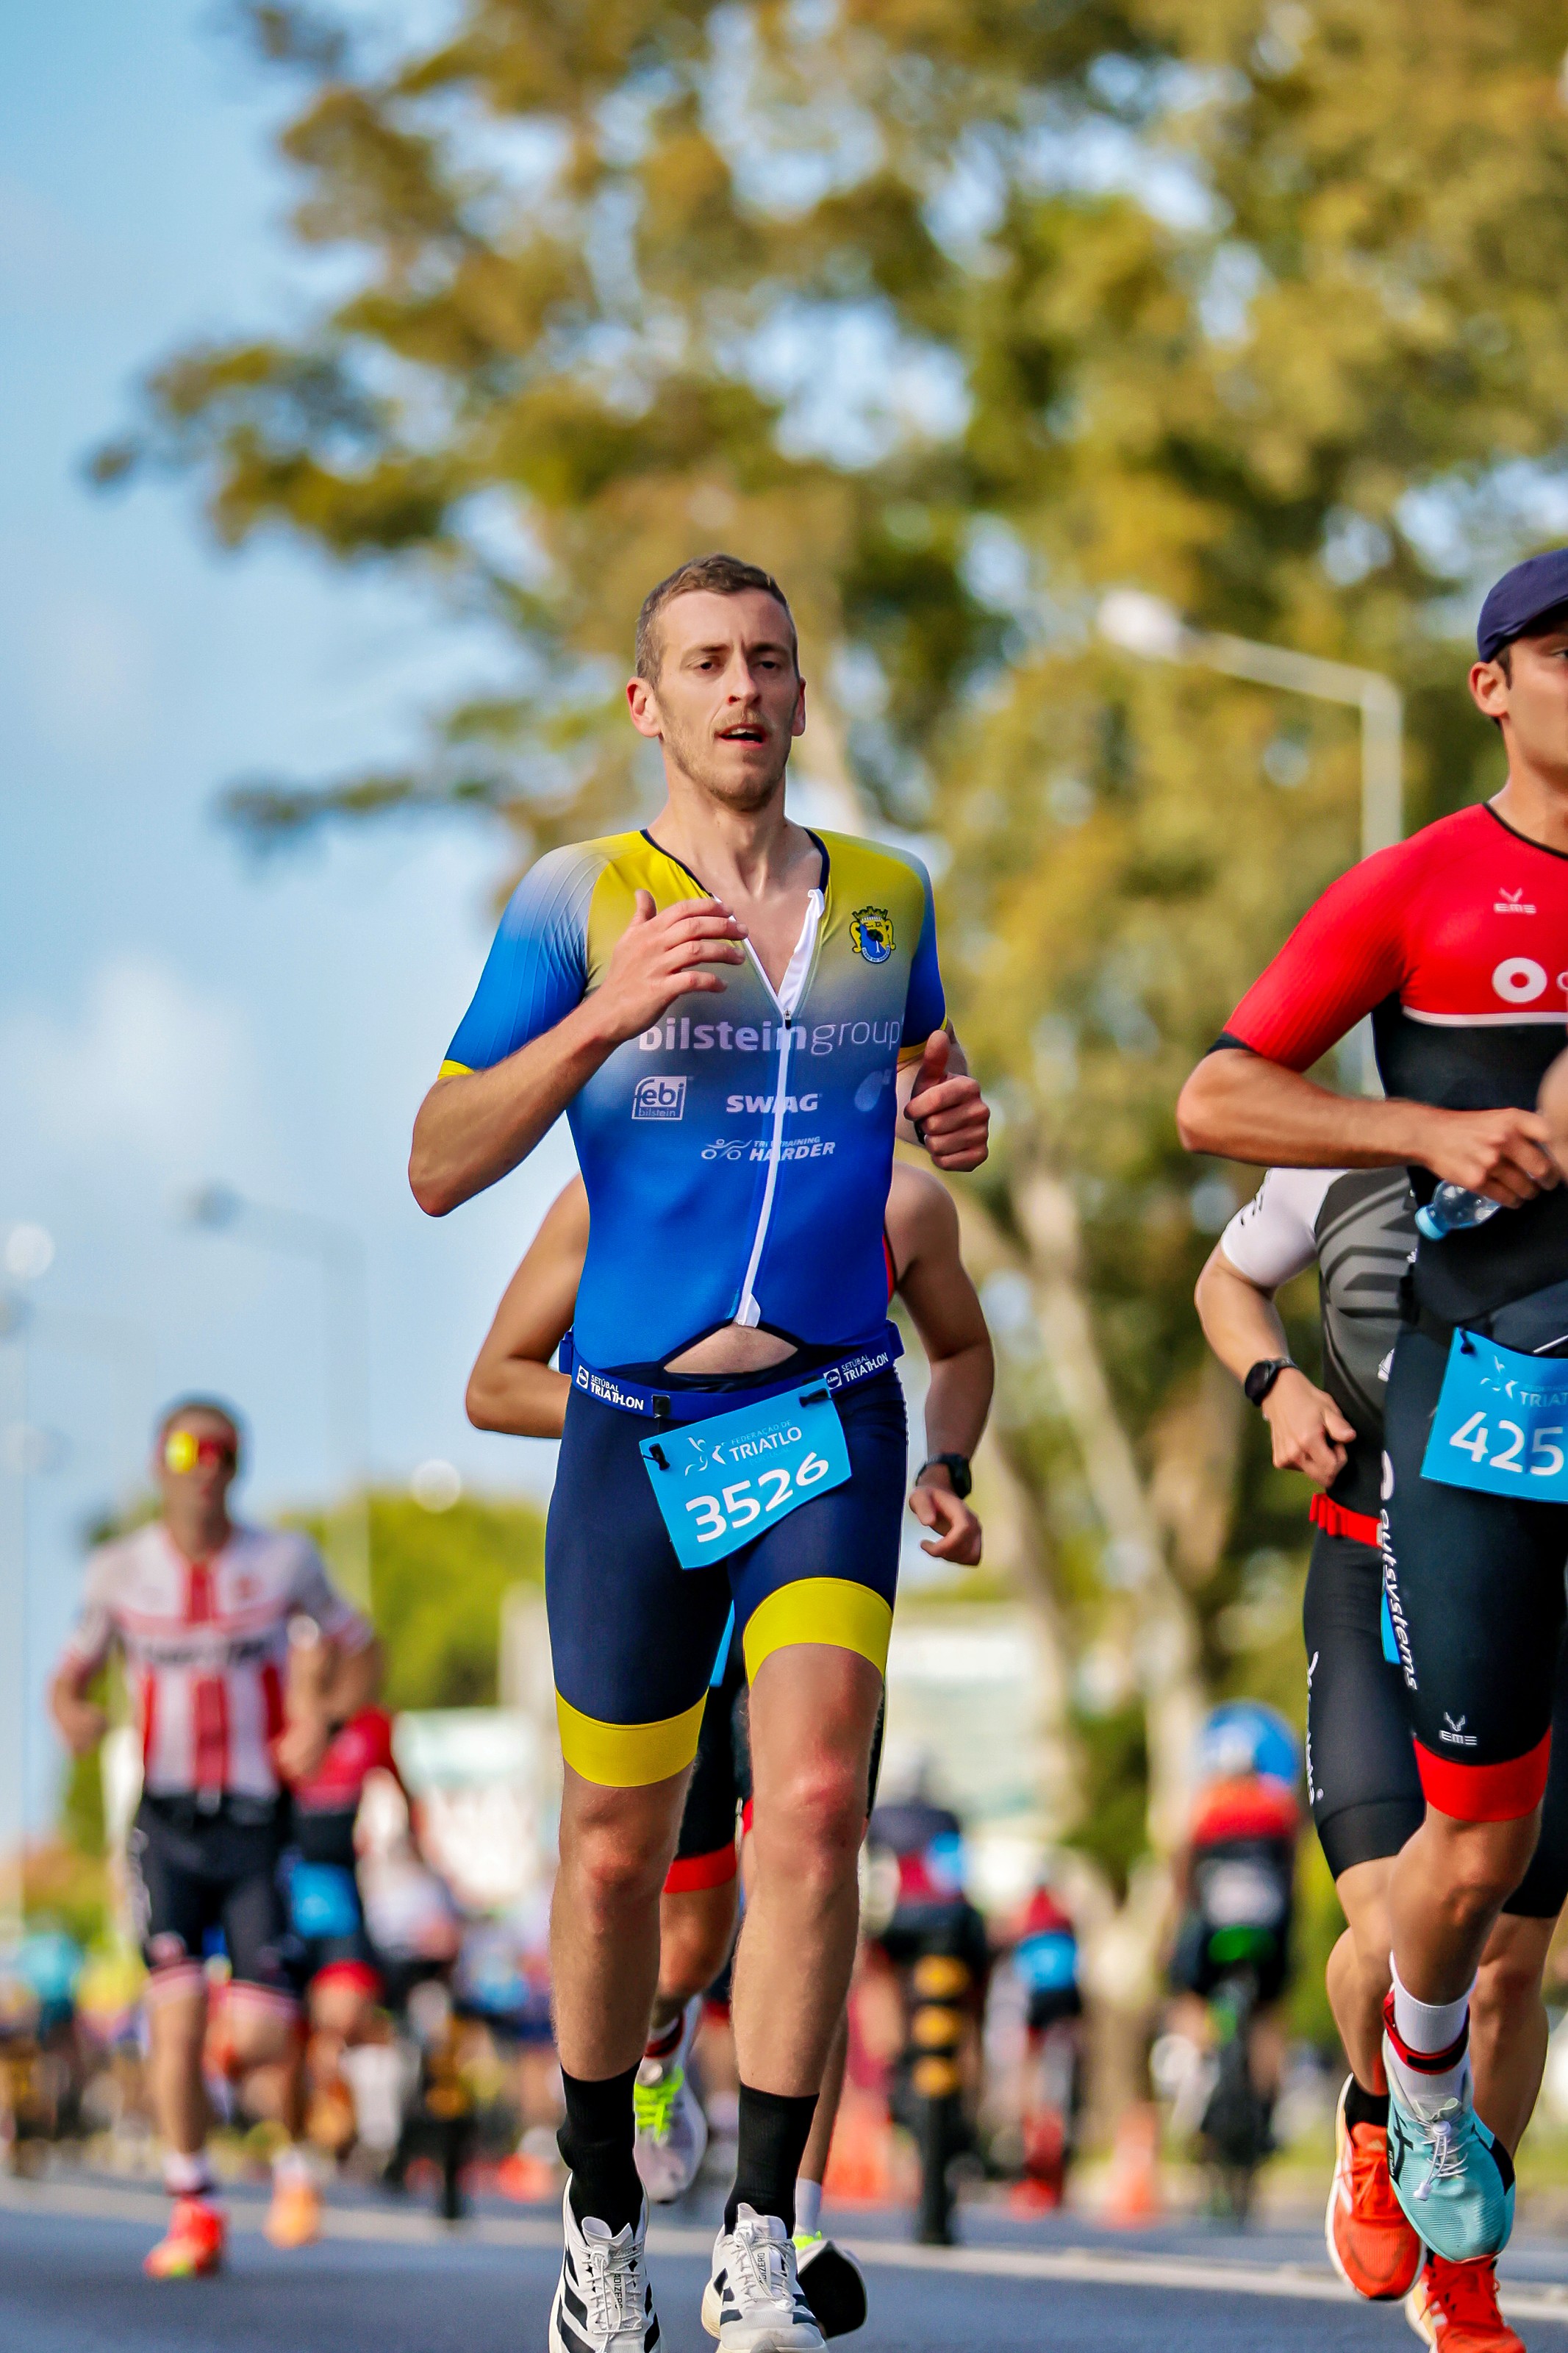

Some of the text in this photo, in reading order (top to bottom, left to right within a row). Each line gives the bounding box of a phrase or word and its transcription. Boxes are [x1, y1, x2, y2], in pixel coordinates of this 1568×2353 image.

[634, 1079, 684, 1105] febi
[726, 1093, 818, 1113] SWAG
[638, 1107, 676, 1117] bilstein
[749, 1142, 836, 1161] HARDER
[844, 1352, 889, 1382] TRIATHLON
[590, 1382, 644, 1410] TRIATHLON
[591, 1374, 619, 1393] SETÚBAL
[729, 1427, 802, 1462] TRIATLO
[1449, 1411, 1564, 1476] 425
[685, 1452, 830, 1543] 3526
